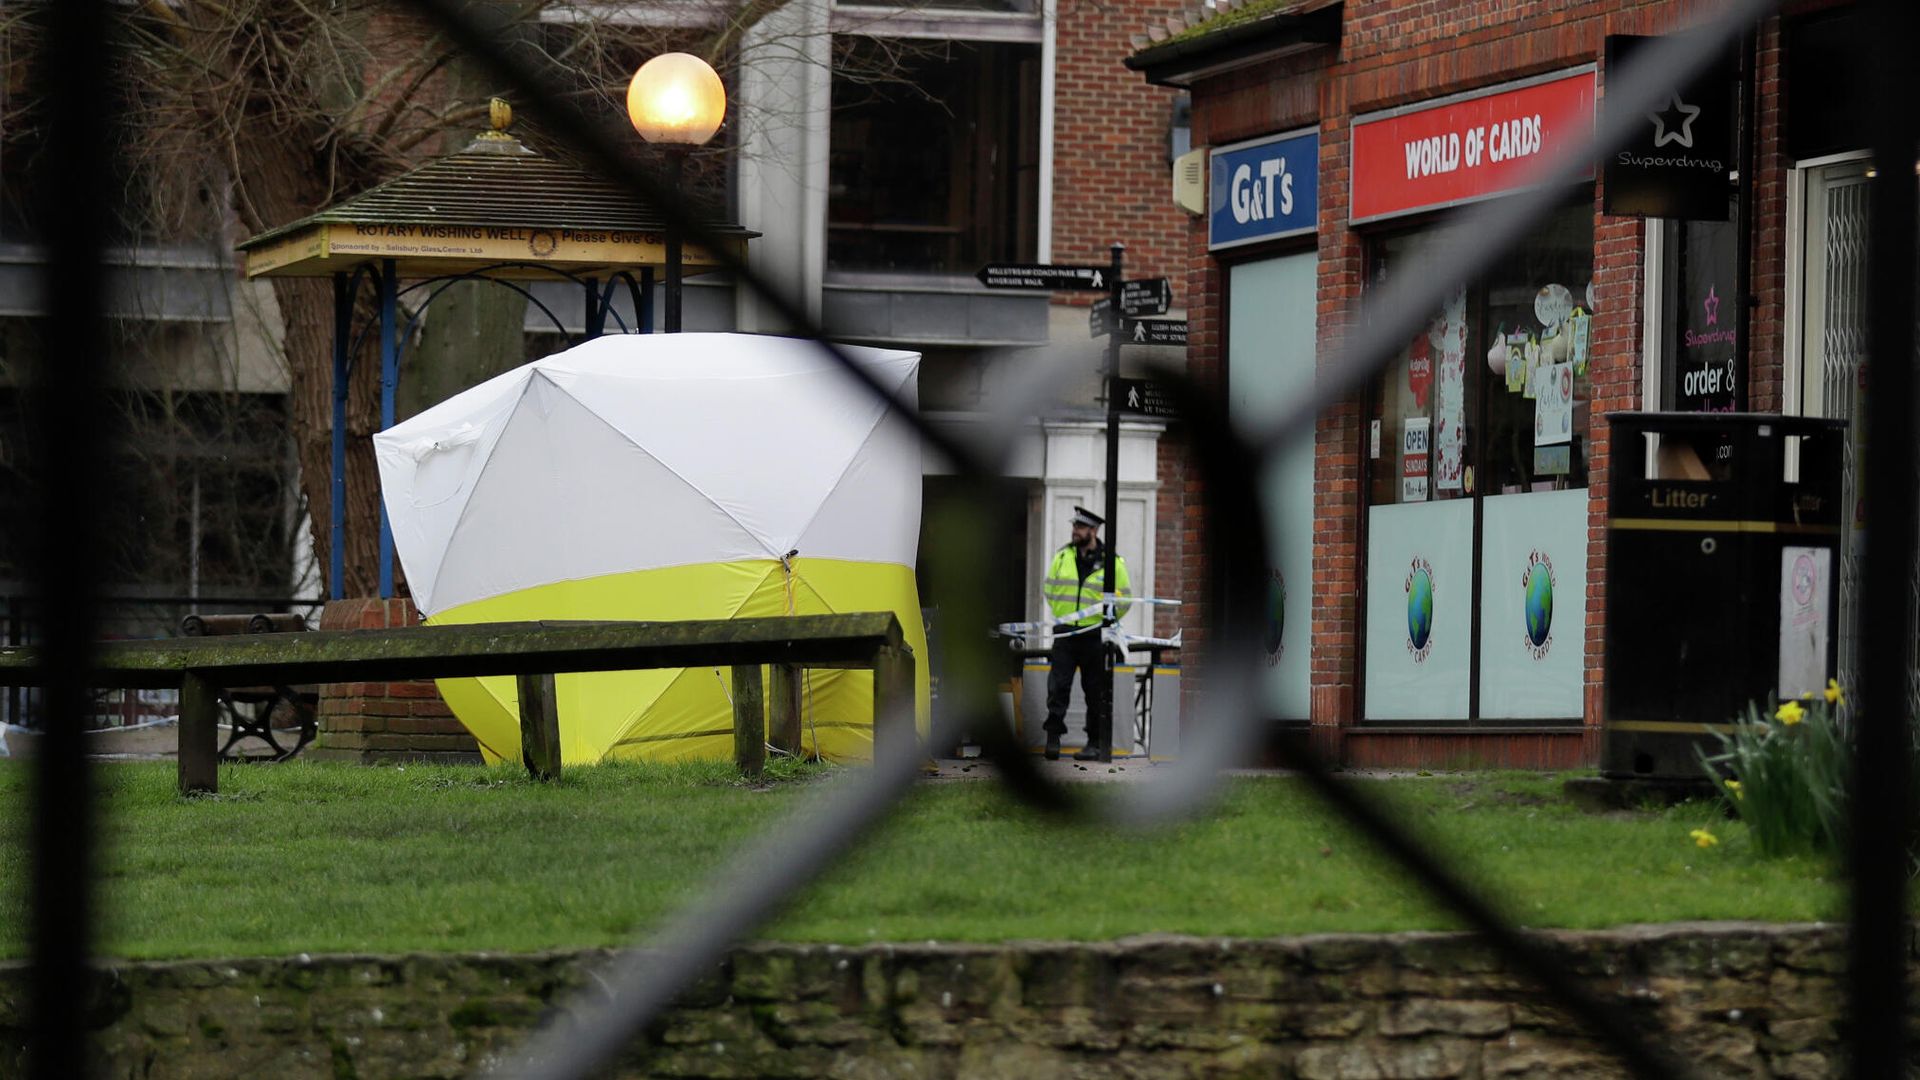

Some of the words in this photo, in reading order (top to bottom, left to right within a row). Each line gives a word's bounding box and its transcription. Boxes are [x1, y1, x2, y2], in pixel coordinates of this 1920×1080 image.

[1405, 133, 1460, 180] WORLD
[1464, 126, 1486, 167] OF
[1488, 114, 1542, 163] CARDS
[1617, 152, 1724, 173] Superdrug
[1231, 156, 1293, 225] G&T's
[356, 225, 416, 237] ROTARY
[421, 226, 482, 239] WISHING
[486, 228, 527, 241] WELL
[562, 230, 606, 243] Please
[611, 231, 641, 244] Give
[330, 242, 370, 251] Sponsored
[370, 244, 380, 253] by
[386, 244, 419, 254] Salisbury
[1024, 277, 1044, 286] WALK
[1033, 268, 1058, 277] COACH
[1058, 269, 1076, 278] PARK
[1684, 328, 1736, 349] Superdrug
[1684, 361, 1723, 397] order
[1725, 359, 1736, 392] &
[1405, 429, 1428, 450] OPEN
[1405, 458, 1428, 474] SUNDAYS
[1651, 488, 1709, 508] Litter
[1532, 636, 1553, 661] CARDS
